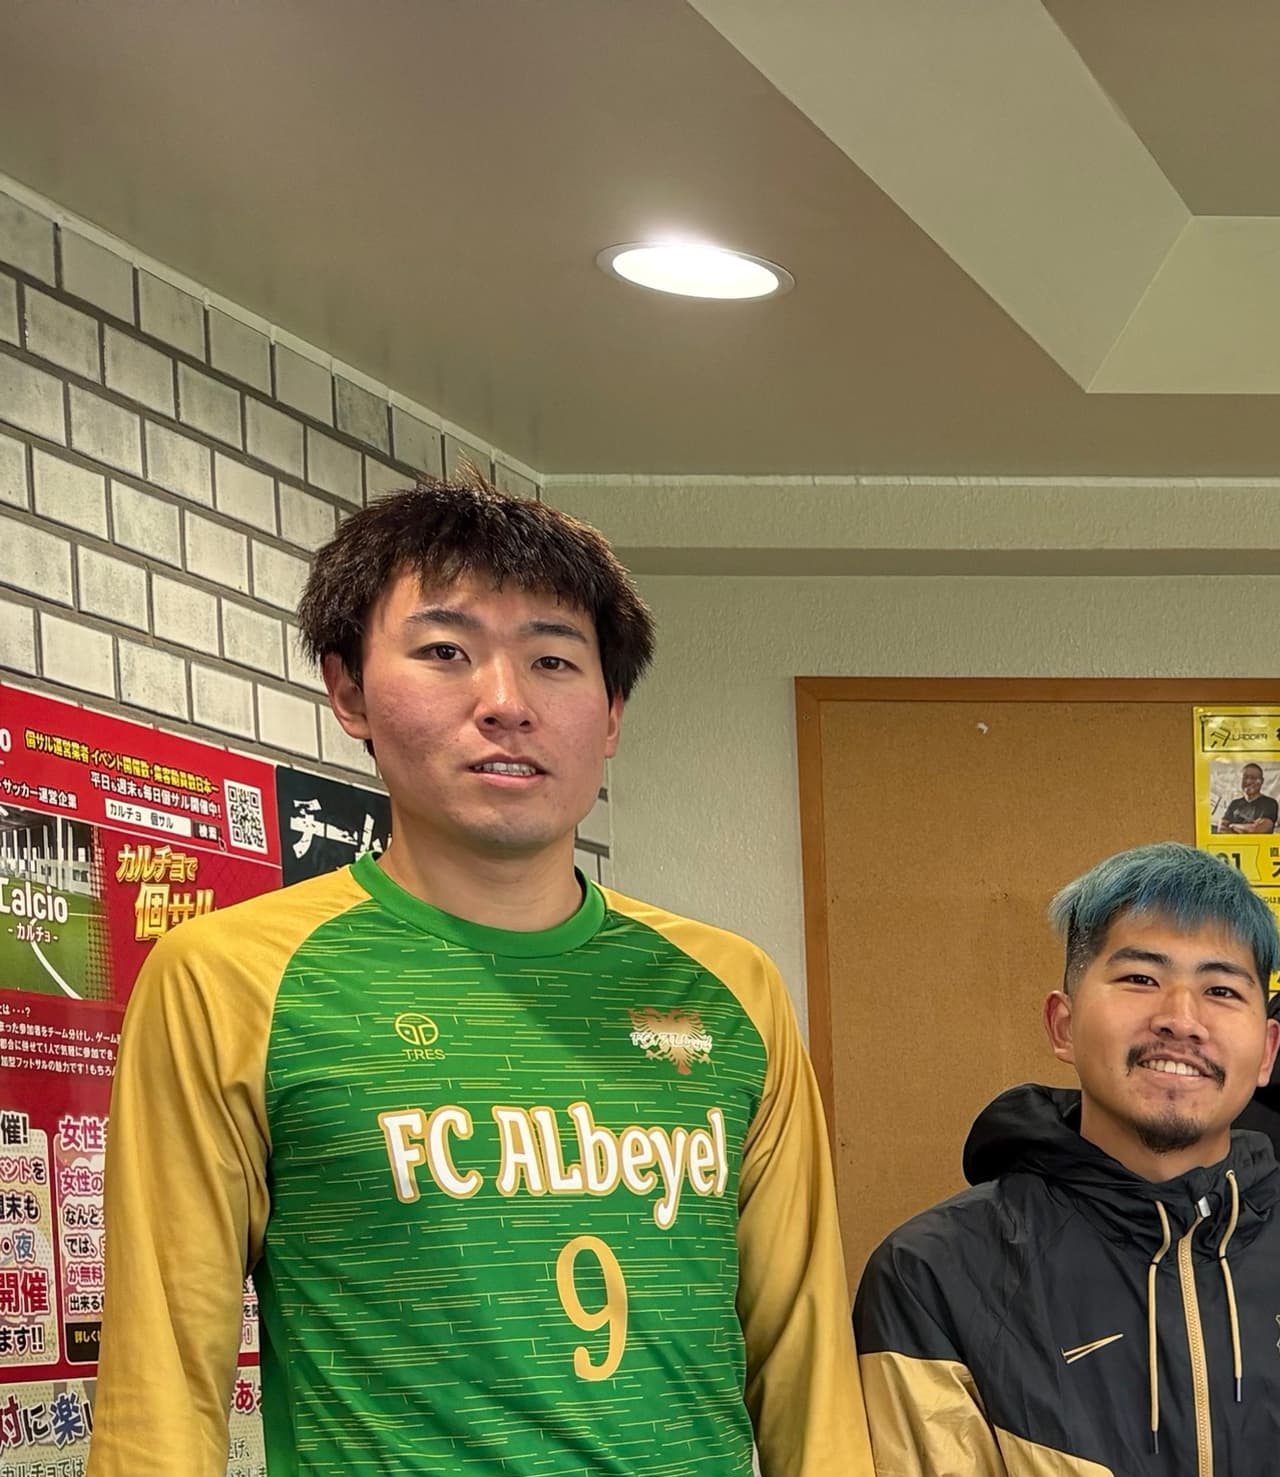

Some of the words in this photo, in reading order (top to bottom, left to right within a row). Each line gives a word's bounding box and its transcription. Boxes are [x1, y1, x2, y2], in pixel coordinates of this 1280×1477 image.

[0, 778, 77, 809] サッカー運営企業
[115, 844, 198, 884] カルチョで
[401, 1049, 446, 1060] TRES
[377, 1105, 483, 1203] FC
[492, 1101, 728, 1230] ALbeyel
[555, 1235, 629, 1381] 9
